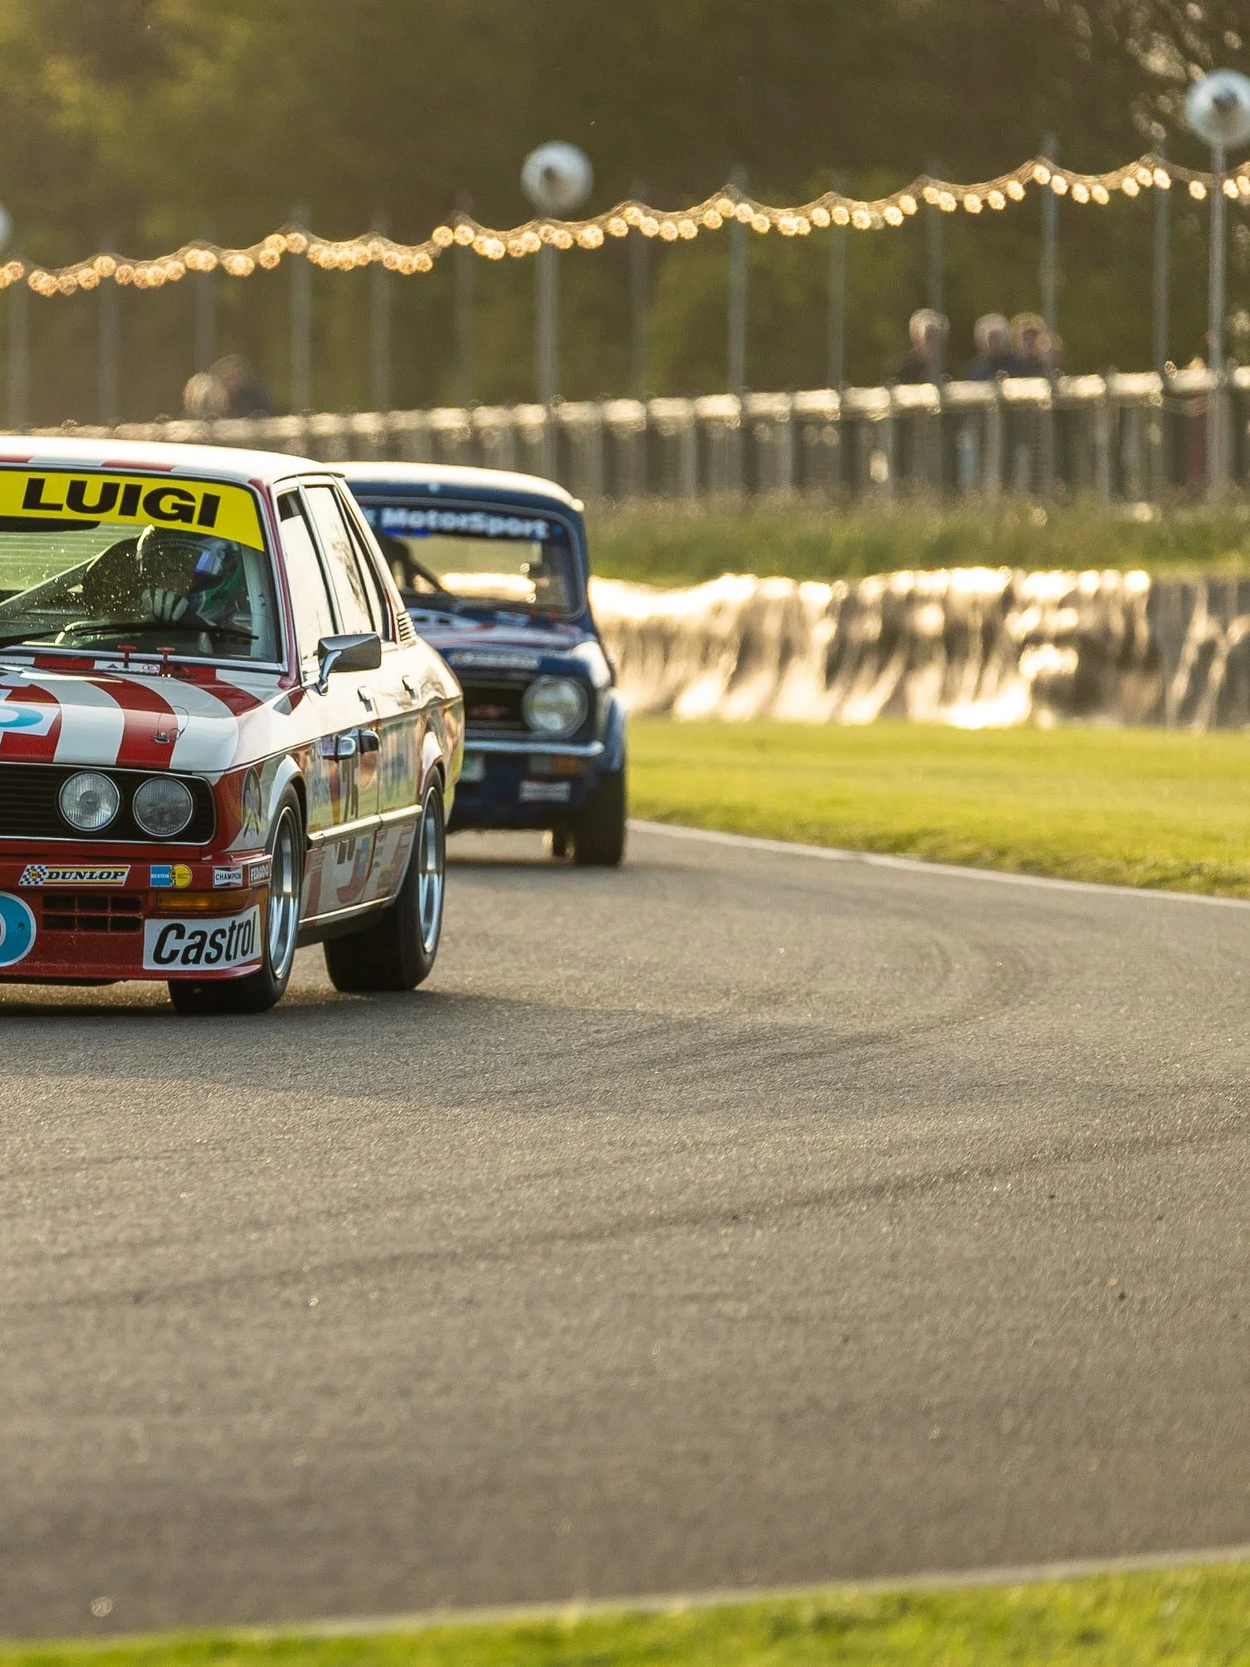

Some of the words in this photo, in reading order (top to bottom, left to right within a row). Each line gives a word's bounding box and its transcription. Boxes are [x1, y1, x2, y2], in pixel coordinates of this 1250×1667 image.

[21, 477, 222, 529] LUIGI
[47, 870, 126, 881] DUNLOP
[215, 872, 242, 881] CHAMPION
[152, 910, 257, 966] Castrol
